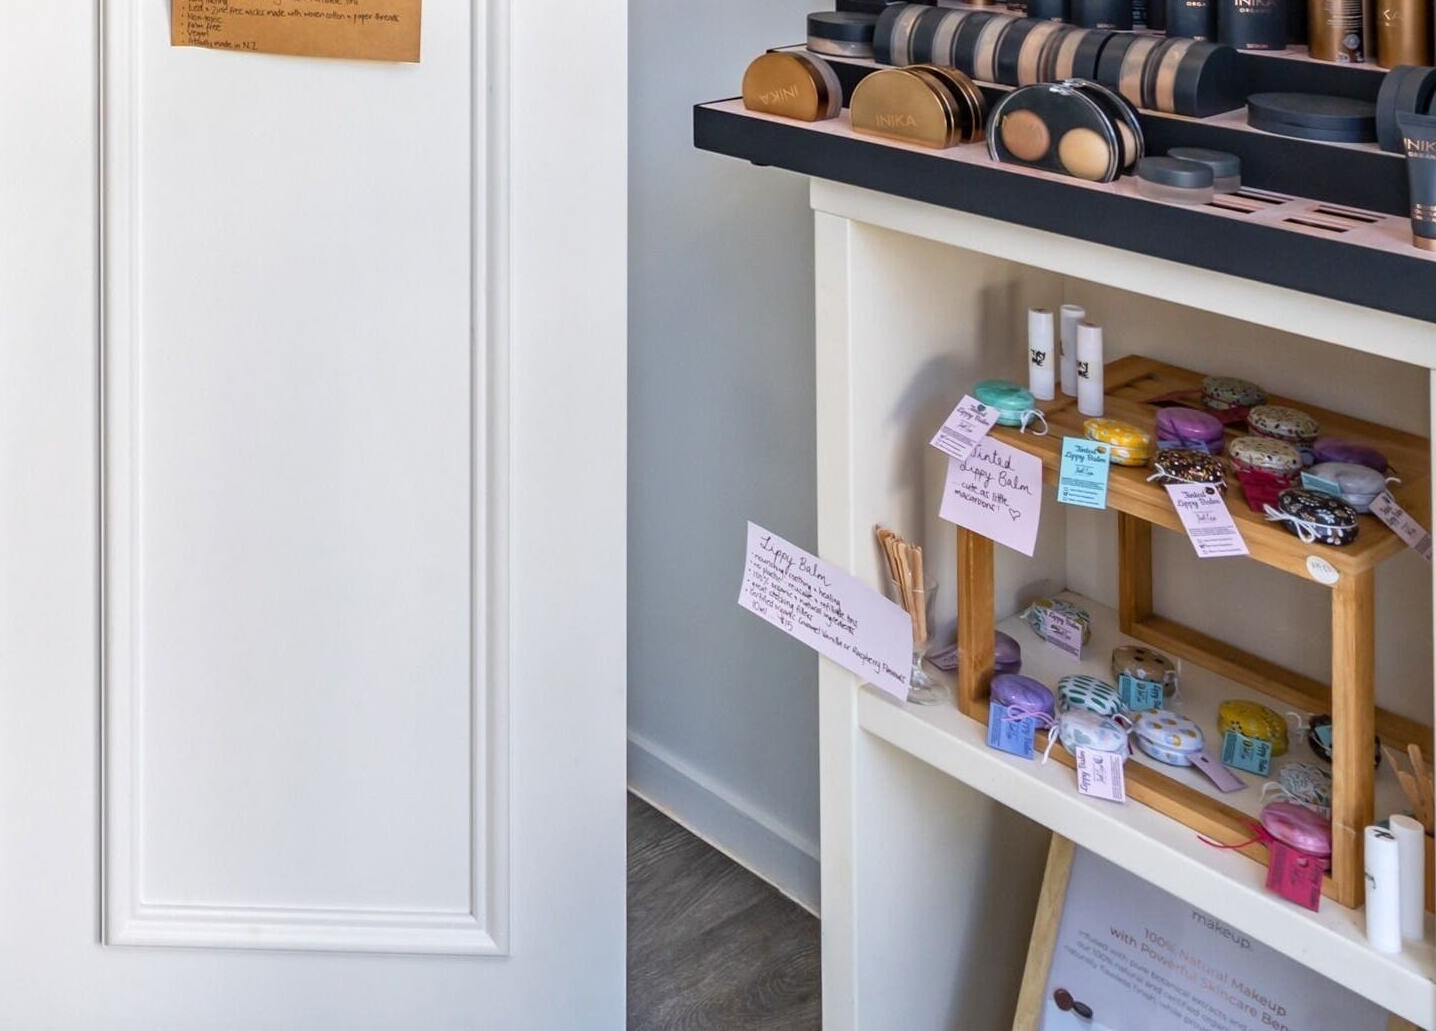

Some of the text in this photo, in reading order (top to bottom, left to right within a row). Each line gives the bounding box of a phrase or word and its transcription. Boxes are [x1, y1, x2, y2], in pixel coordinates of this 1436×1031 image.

[876, 115, 916, 127] INIKA
[970, 444, 1015, 470] Tinted
[998, 471, 1032, 495] Balm
[980, 489, 989, 498] as
[992, 491, 1010, 507] little
[760, 536, 833, 587] Lippy Balm
[1110, 926, 1257, 1018] with Powerful Skincare
[1179, 949, 1228, 983] Natural
[1232, 978, 1286, 1018] Makeup
[1145, 981, 1162, 994] and
[1192, 995, 1247, 1030] extracts and
